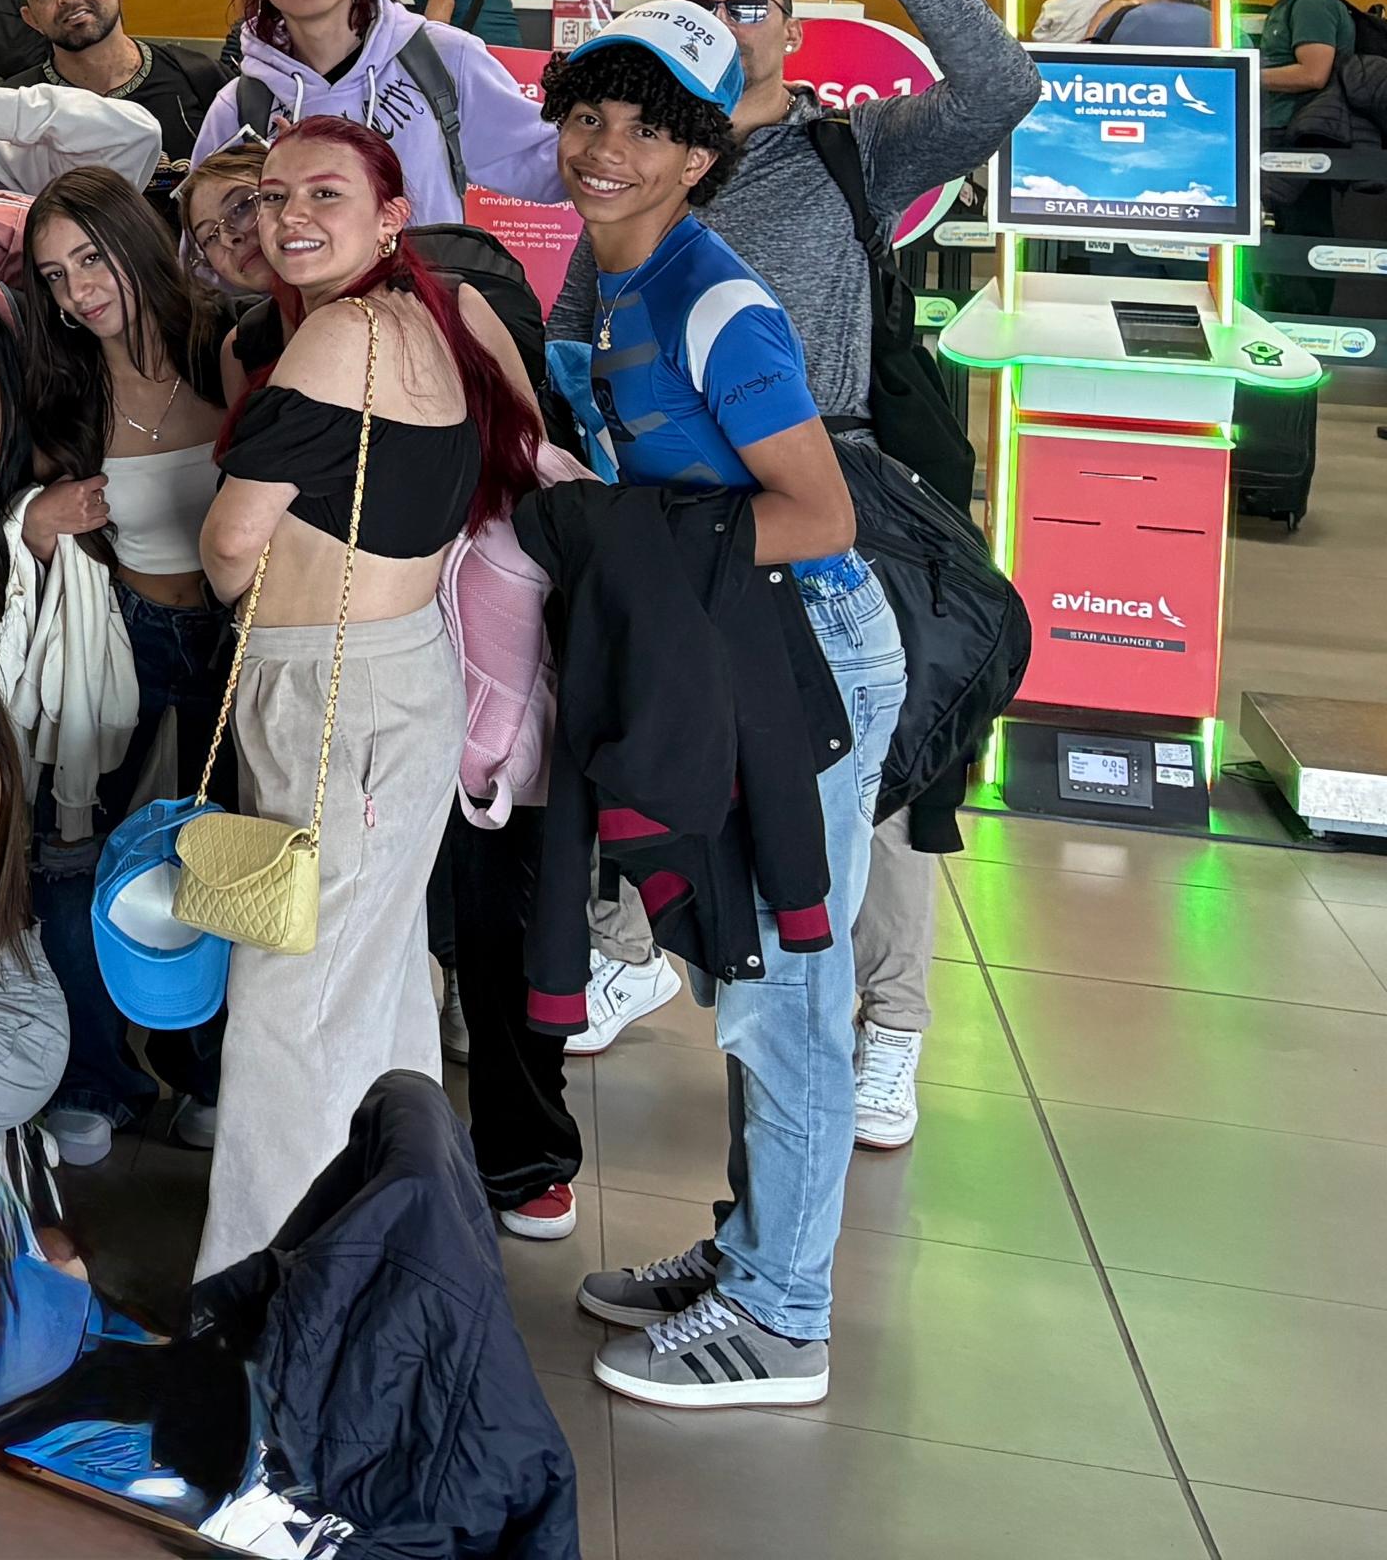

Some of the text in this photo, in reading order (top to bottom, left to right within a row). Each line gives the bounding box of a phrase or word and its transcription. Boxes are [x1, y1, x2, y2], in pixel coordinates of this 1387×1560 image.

[625, 10, 716, 46] Prom 2025
[1040, 74, 1168, 105] avianca
[1045, 200, 1180, 218] STAR ALLIANCE
[513, 221, 529, 229] bag
[1051, 590, 1153, 619] avianca
